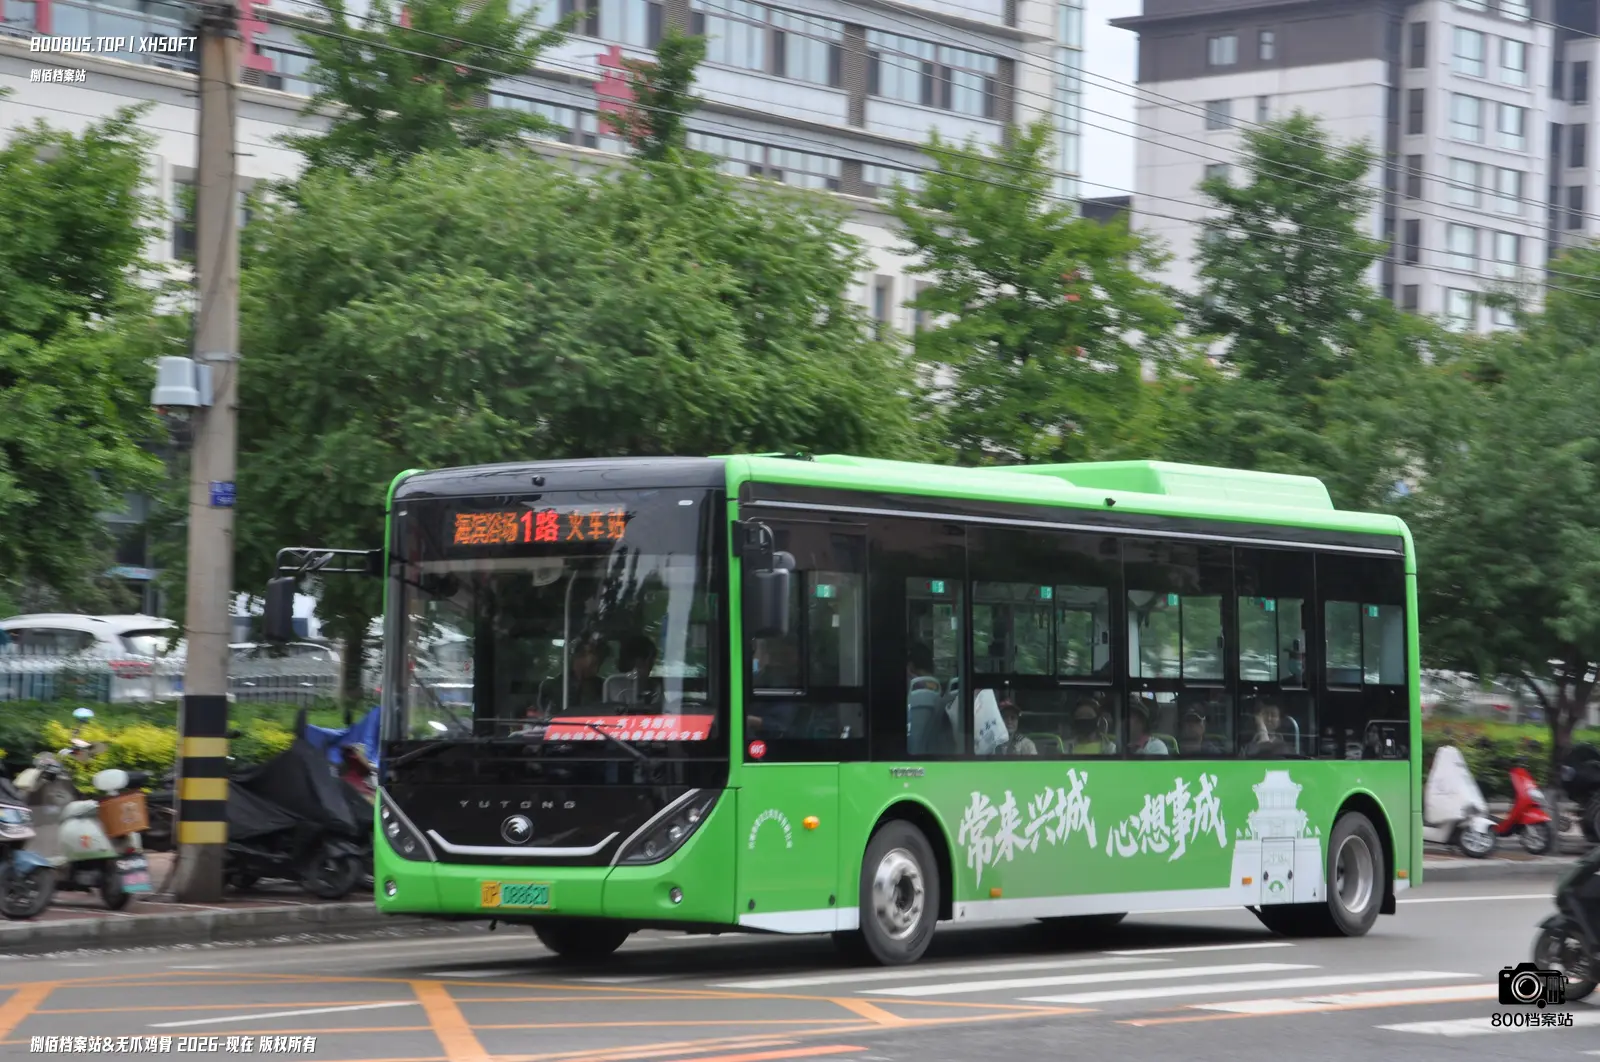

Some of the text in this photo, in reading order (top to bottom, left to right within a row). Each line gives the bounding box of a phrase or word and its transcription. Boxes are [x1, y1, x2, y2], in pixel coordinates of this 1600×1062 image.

[520, 510, 560, 542] 1路
[565, 510, 627, 542] 火车站
[459, 800, 577, 809] YUTONG
[958, 768, 1228, 890] 常来兴城 心想事成
